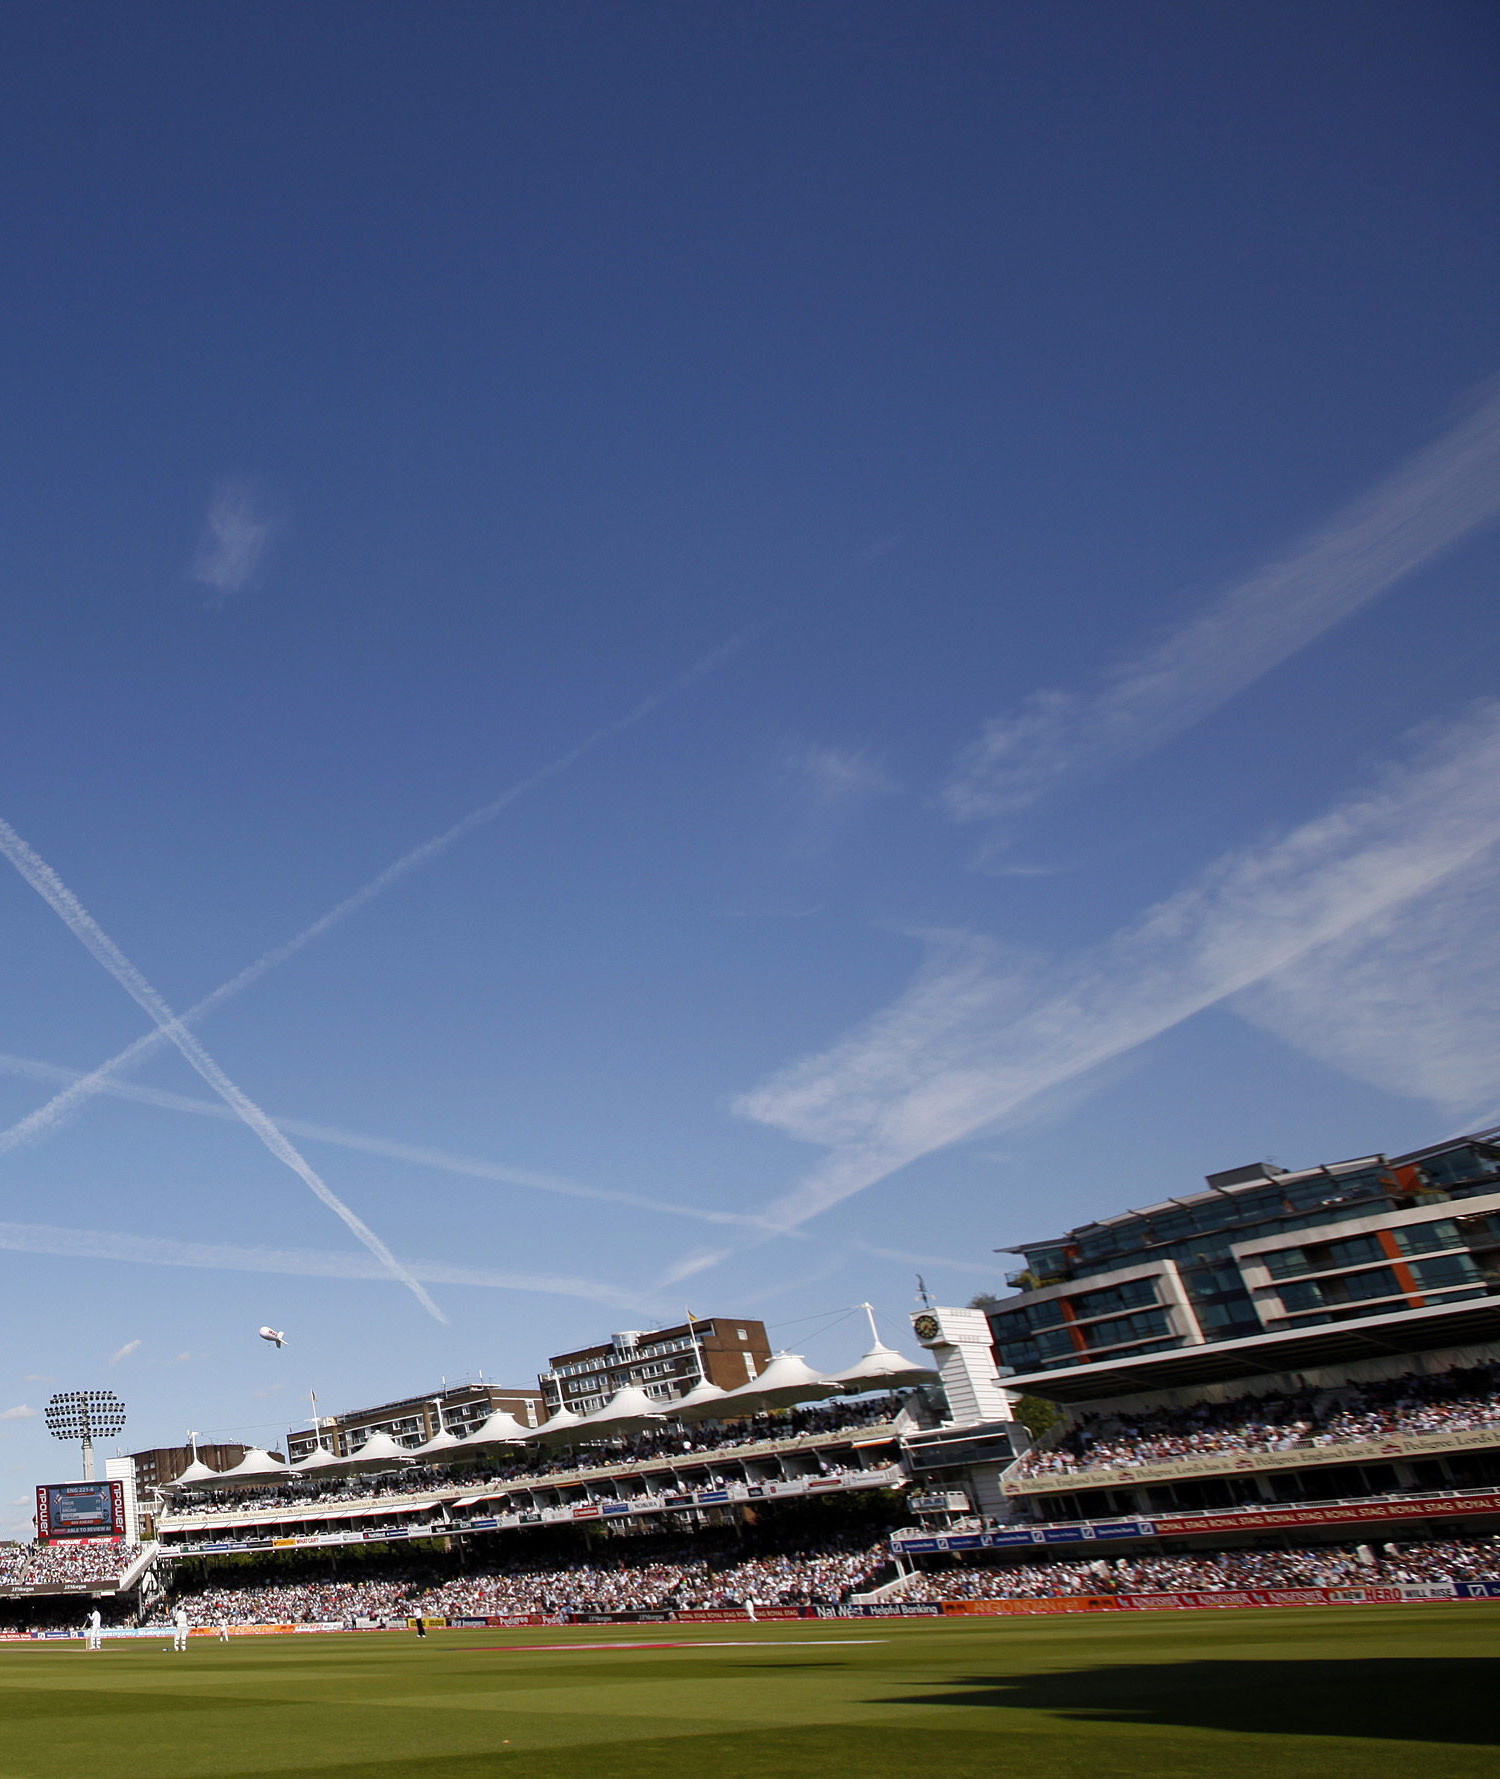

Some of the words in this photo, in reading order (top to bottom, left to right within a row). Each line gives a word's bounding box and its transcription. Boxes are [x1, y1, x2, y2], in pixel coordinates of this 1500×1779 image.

[1301, 1448, 1344, 1463] England
[38, 1487, 49, 1536] npower
[113, 1483, 124, 1532] npower
[1155, 1521, 1182, 1531] ROYAL
[1184, 1520, 1207, 1530] STAG
[1209, 1518, 1236, 1528] ROYAL
[1238, 1514, 1263, 1525] STAG
[1265, 1513, 1295, 1524] ROYAL
[1297, 1511, 1323, 1522] STAG
[1324, 1509, 1358, 1519] ROYAL
[1359, 1507, 1387, 1518] STAG
[1389, 1505, 1423, 1514] ROYAL
[1425, 1502, 1453, 1512] STAG
[1455, 1499, 1494, 1510] ROYAL
[1197, 1592, 1252, 1605] KINGFISHER
[1266, 1590, 1328, 1604] KINGFISHER
[1342, 1590, 1363, 1600] NEW
[1365, 1588, 1400, 1600] HERO
[1404, 1588, 1426, 1598] WILL
[1430, 1588, 1453, 1597] RISE
[974, 1602, 1011, 1613] ANGLO
[1012, 1601, 1056, 1612] INDIAN
[1131, 1595, 1183, 1608] KINGFISHER
[707, 1611, 723, 1619] ROYAL
[870, 1604, 900, 1616] Helpful
[902, 1604, 938, 1616] Banking
[500, 1616, 529, 1626] Pedigree
